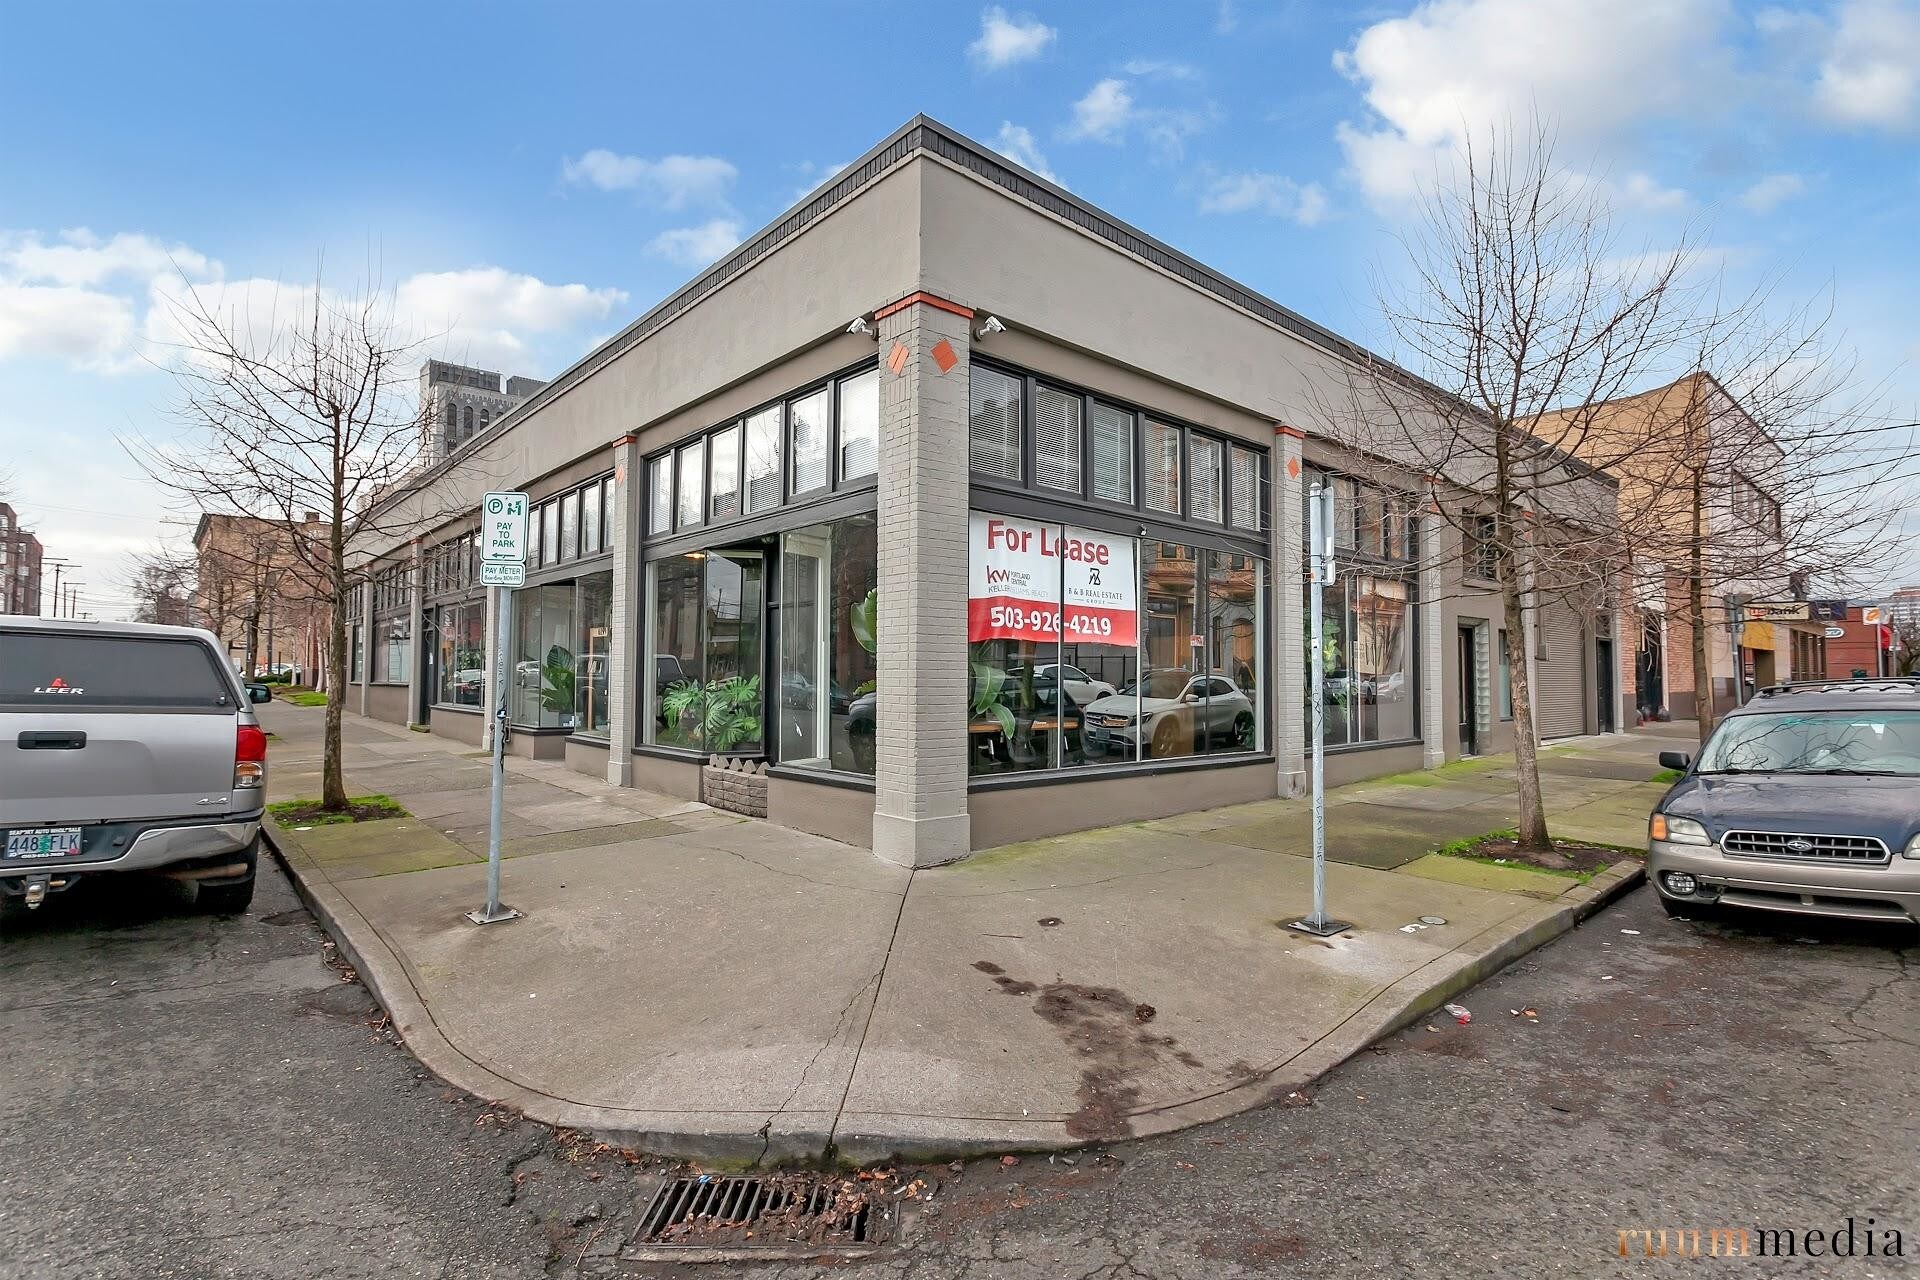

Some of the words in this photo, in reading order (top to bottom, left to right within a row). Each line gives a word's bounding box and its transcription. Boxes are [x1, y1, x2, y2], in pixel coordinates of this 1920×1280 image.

[496, 522, 513, 530] PAY
[498, 531, 510, 539] TO
[492, 540, 515, 548] PARK
[987, 519, 1033, 553] For
[1040, 527, 1109, 566] Lease
[499, 567, 521, 575] METER
[1085, 589, 1101, 598] REAL
[1101, 591, 1123, 600] ESTATE
[990, 606, 1112, 636] 503-926-4219
[33, 686, 84, 695] LEER
[9, 836, 39, 853] 448
[49, 834, 79, 850] FLK
